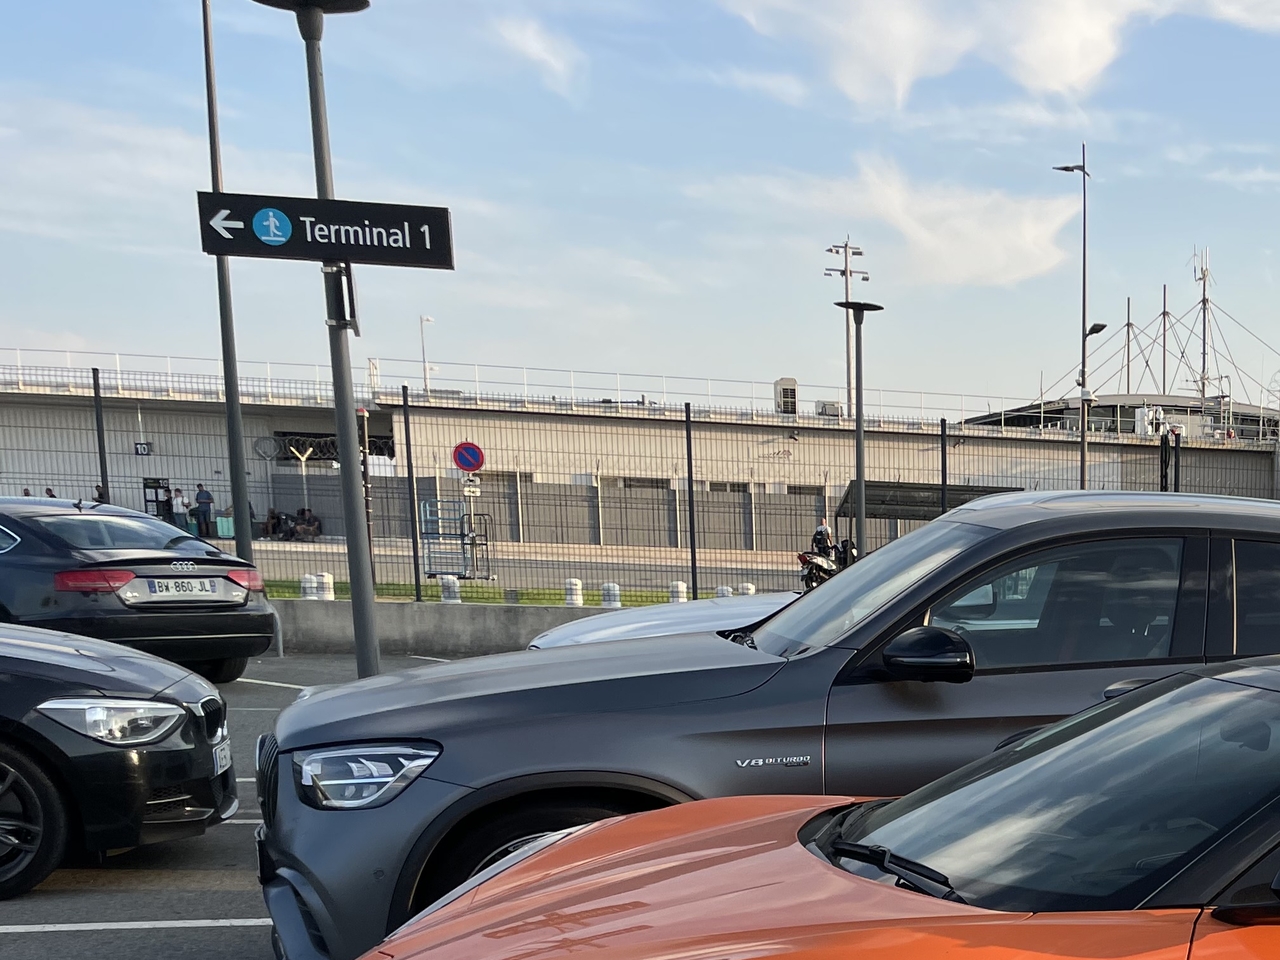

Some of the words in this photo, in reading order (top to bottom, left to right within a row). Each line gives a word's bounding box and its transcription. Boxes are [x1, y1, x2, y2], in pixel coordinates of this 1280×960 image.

[299, 216, 411, 248] Terminal
[420, 224, 431, 249] 1
[136, 444, 148, 455] 10
[736, 758, 764, 767] V8
